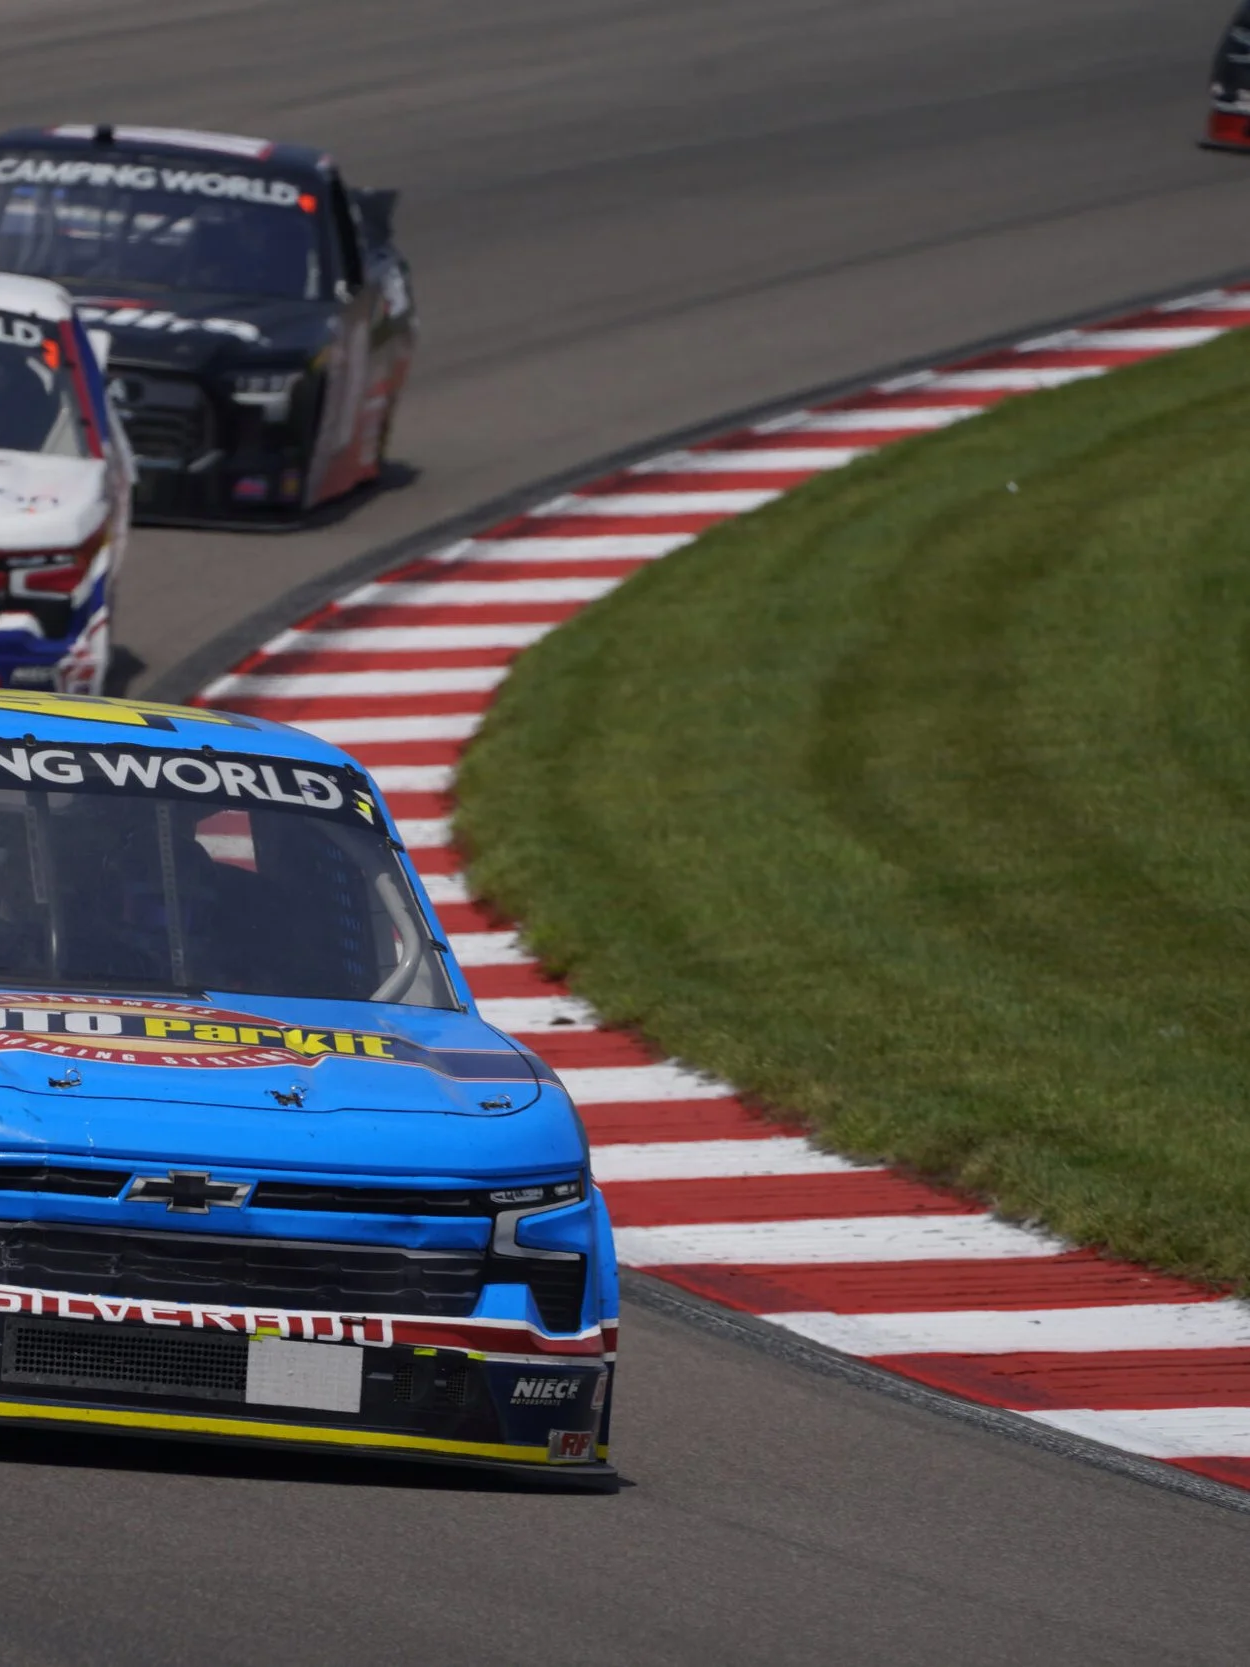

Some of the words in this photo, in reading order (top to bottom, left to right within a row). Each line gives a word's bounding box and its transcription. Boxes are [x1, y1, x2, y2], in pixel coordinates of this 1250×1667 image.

[160, 168, 299, 207] WORLD
[88, 752, 344, 810] WORLD
[144, 1016, 395, 1059] Parkit
[160, 1050, 298, 1067] SYSTEMS
